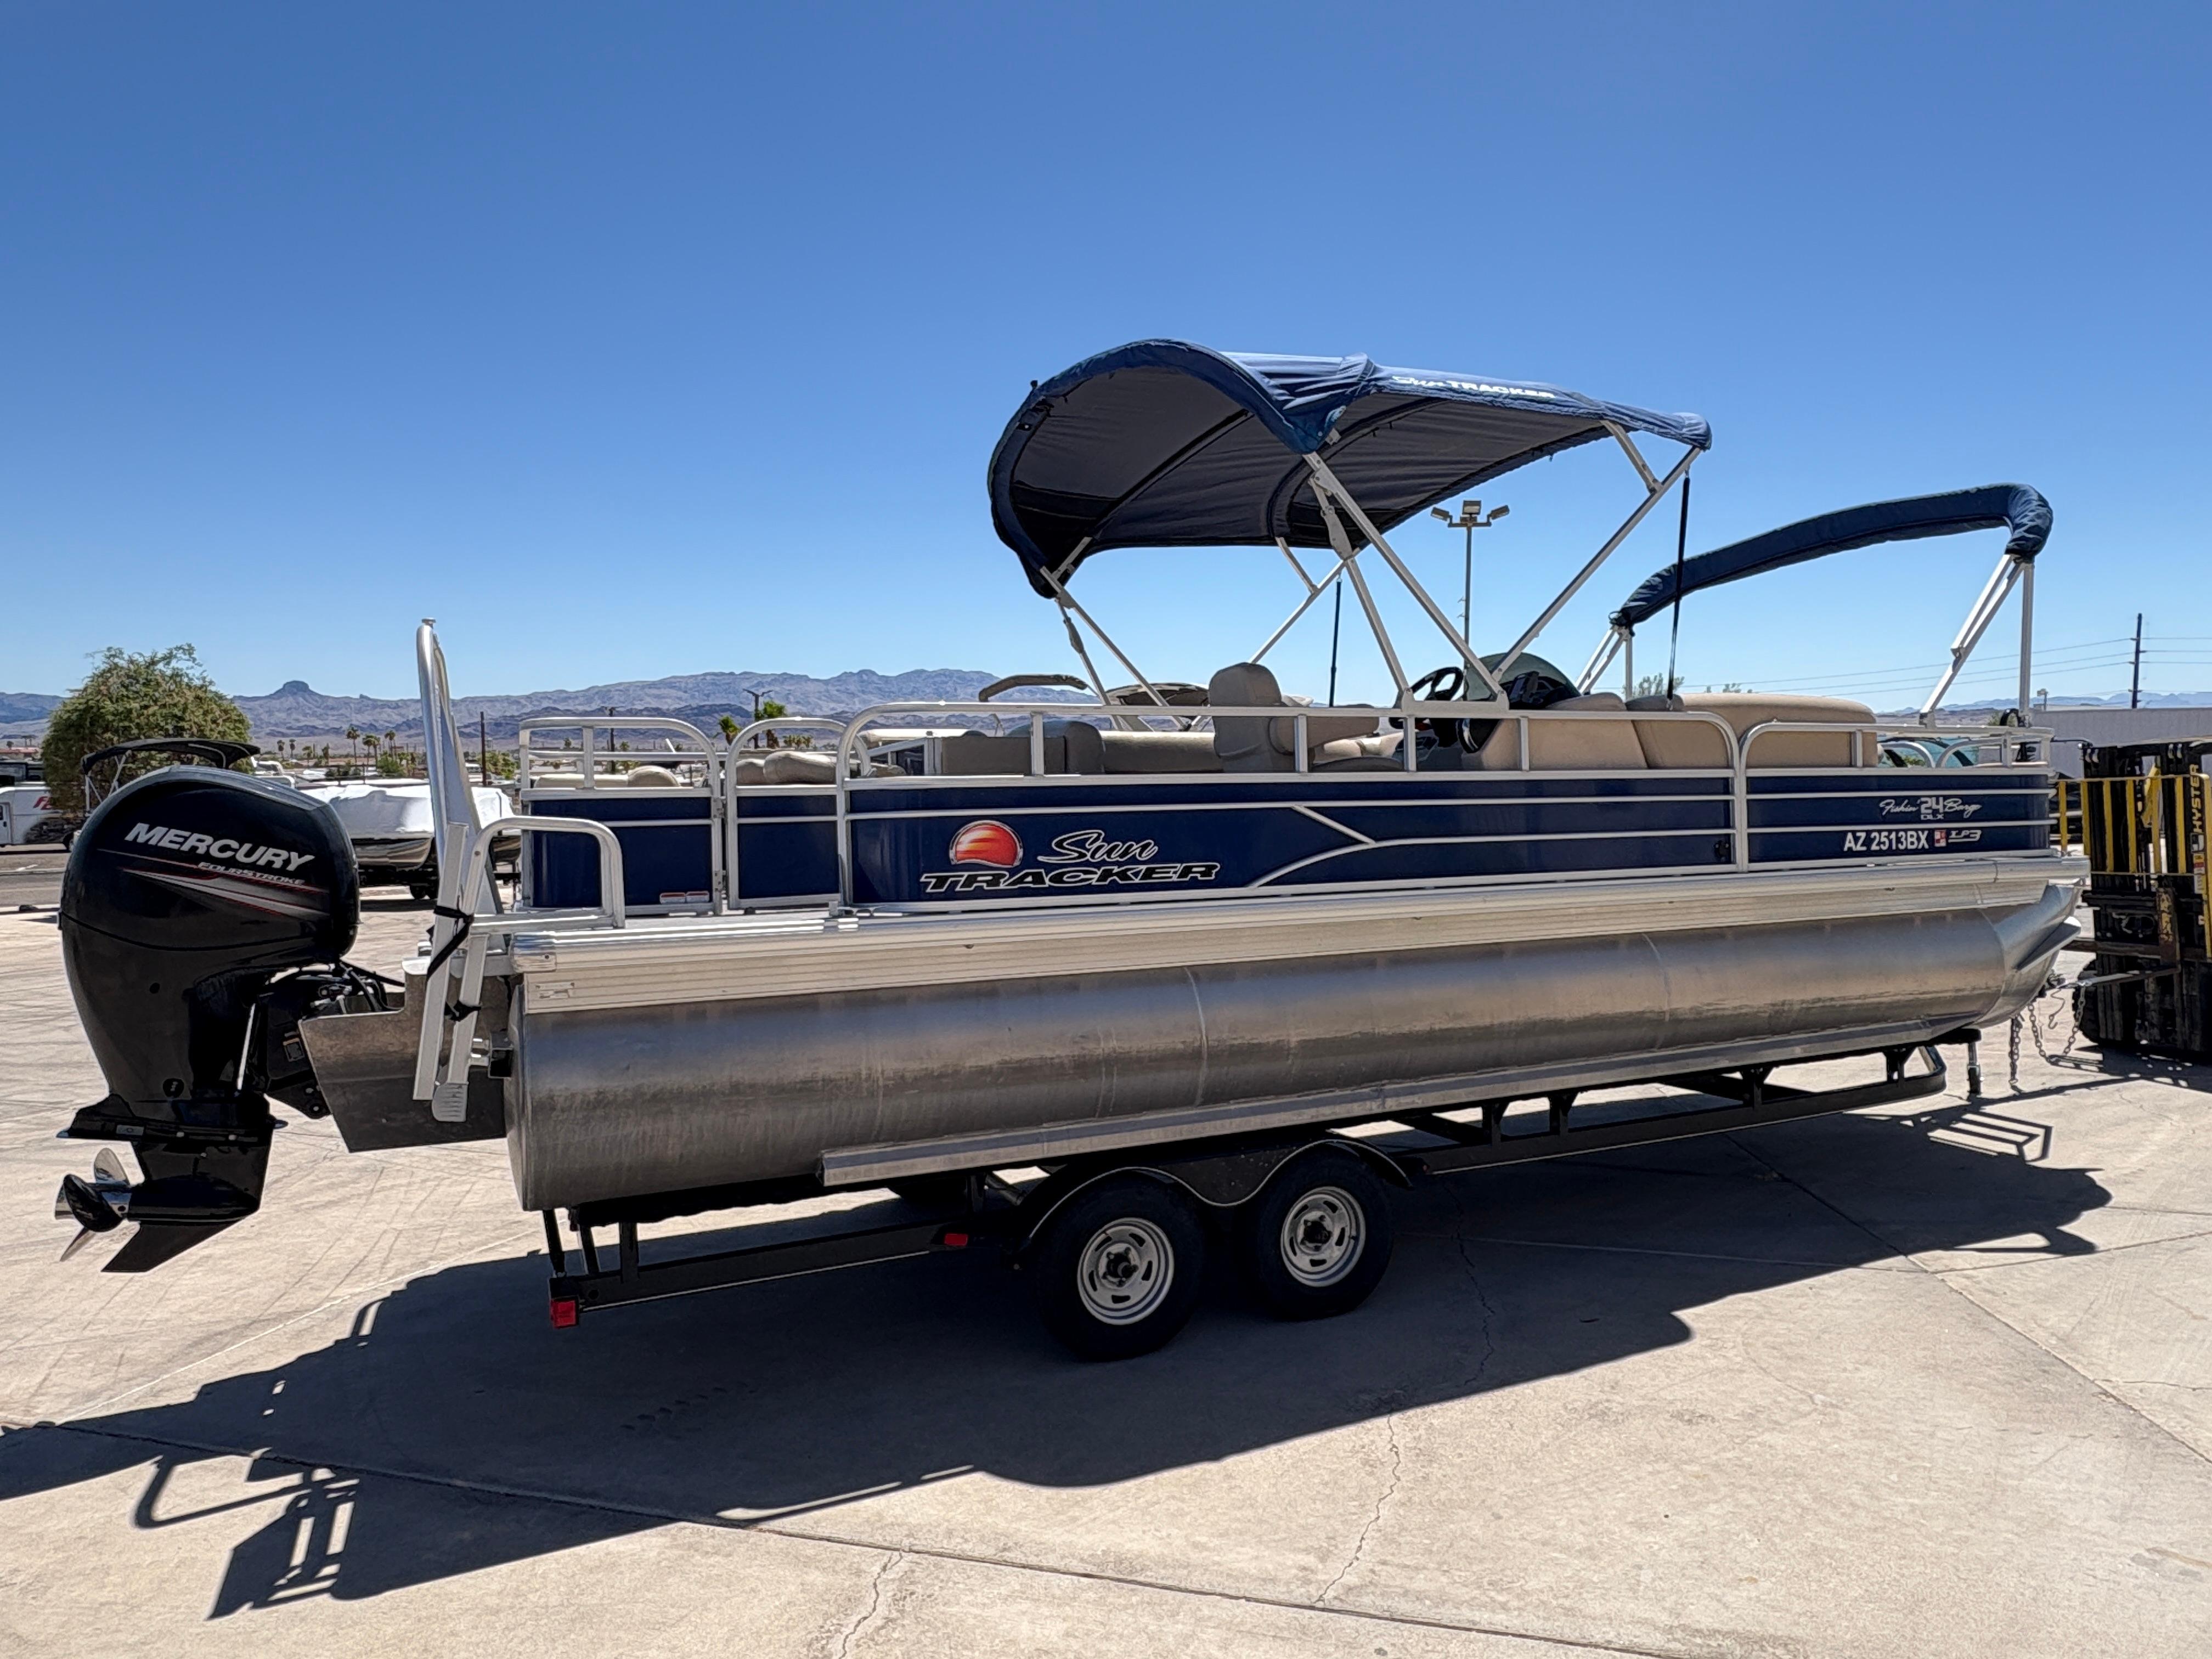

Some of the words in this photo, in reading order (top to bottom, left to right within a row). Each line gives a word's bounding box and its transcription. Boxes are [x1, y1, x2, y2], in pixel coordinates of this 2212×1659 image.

[1446, 380, 1556, 398] TRACKER
[1921, 797, 1944, 814] 24
[2190, 764, 2202, 833] HYSTER
[124, 822, 315, 871] MERCURY
[1037, 830, 1159, 864] Sun
[1843, 832, 1867, 851] AZ
[1870, 830, 1929, 851] 2513BX
[920, 862, 1220, 893] TRACKER
